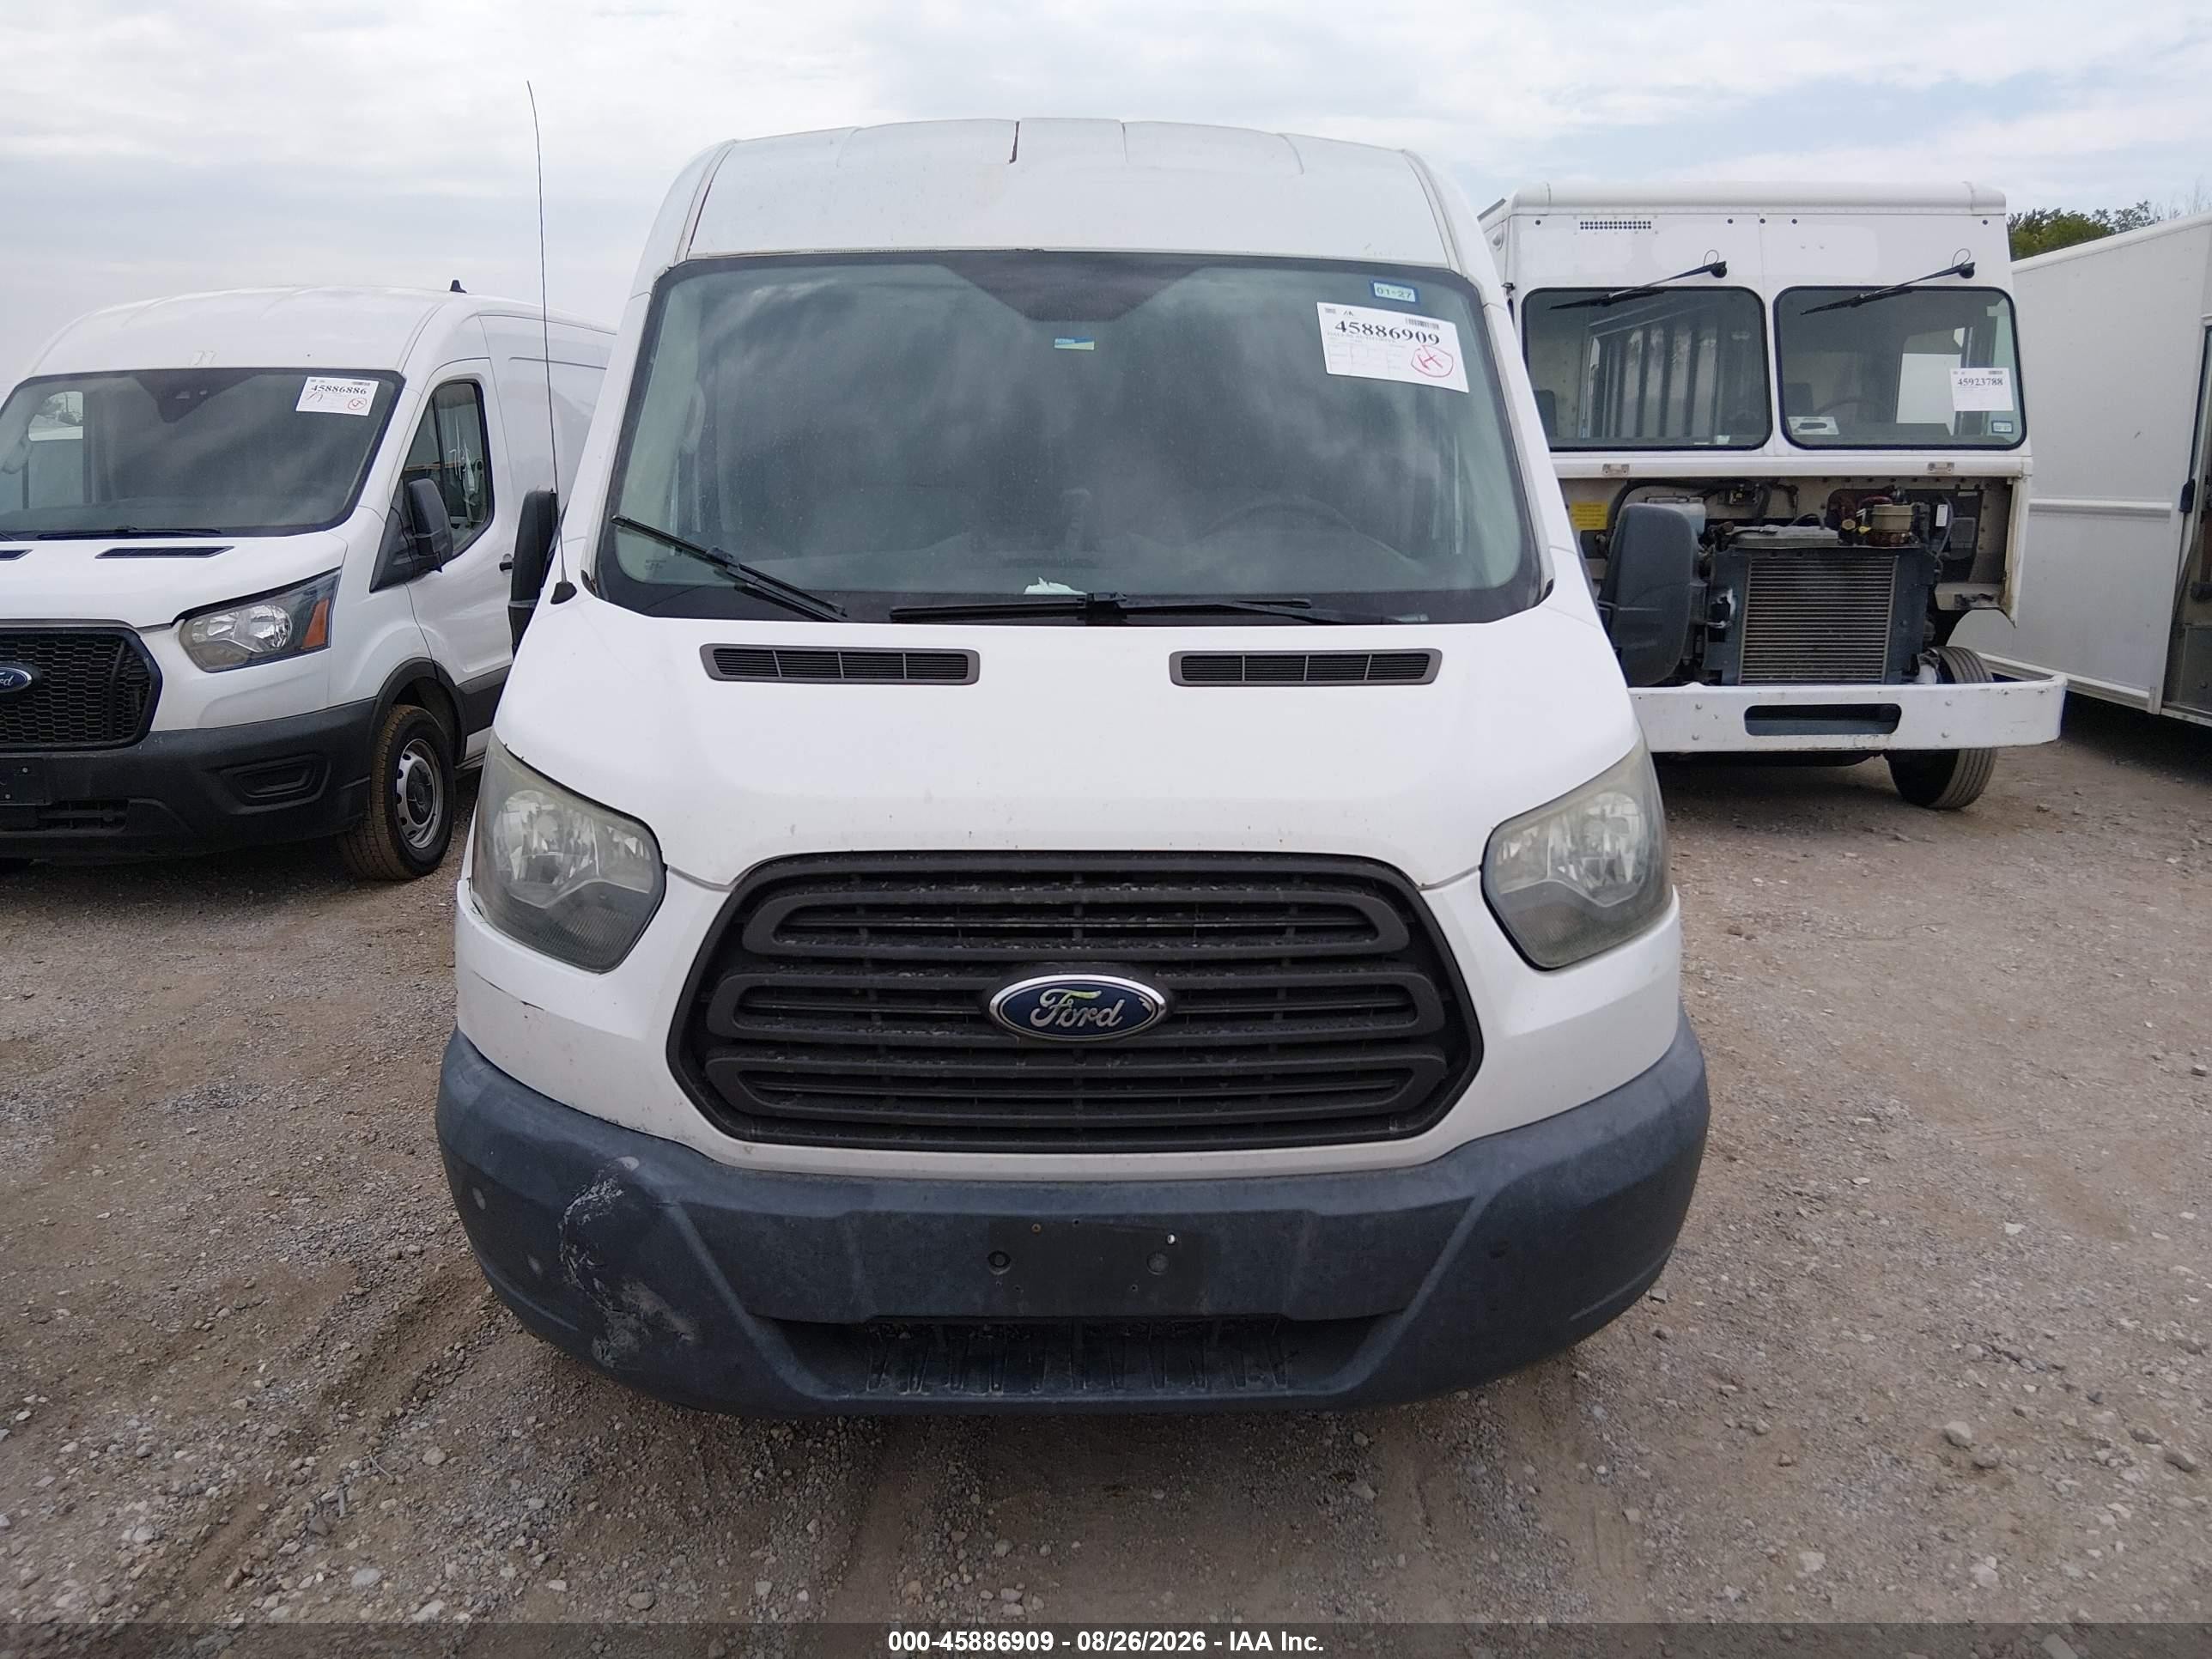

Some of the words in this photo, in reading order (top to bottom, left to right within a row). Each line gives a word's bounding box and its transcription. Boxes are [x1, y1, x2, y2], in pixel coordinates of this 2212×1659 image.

[1334, 319, 1440, 345] 45886909
[311, 384, 367, 395] 45886886
[1957, 377, 2003, 386] 45923788
[1030, 988, 1126, 1028] Ford
